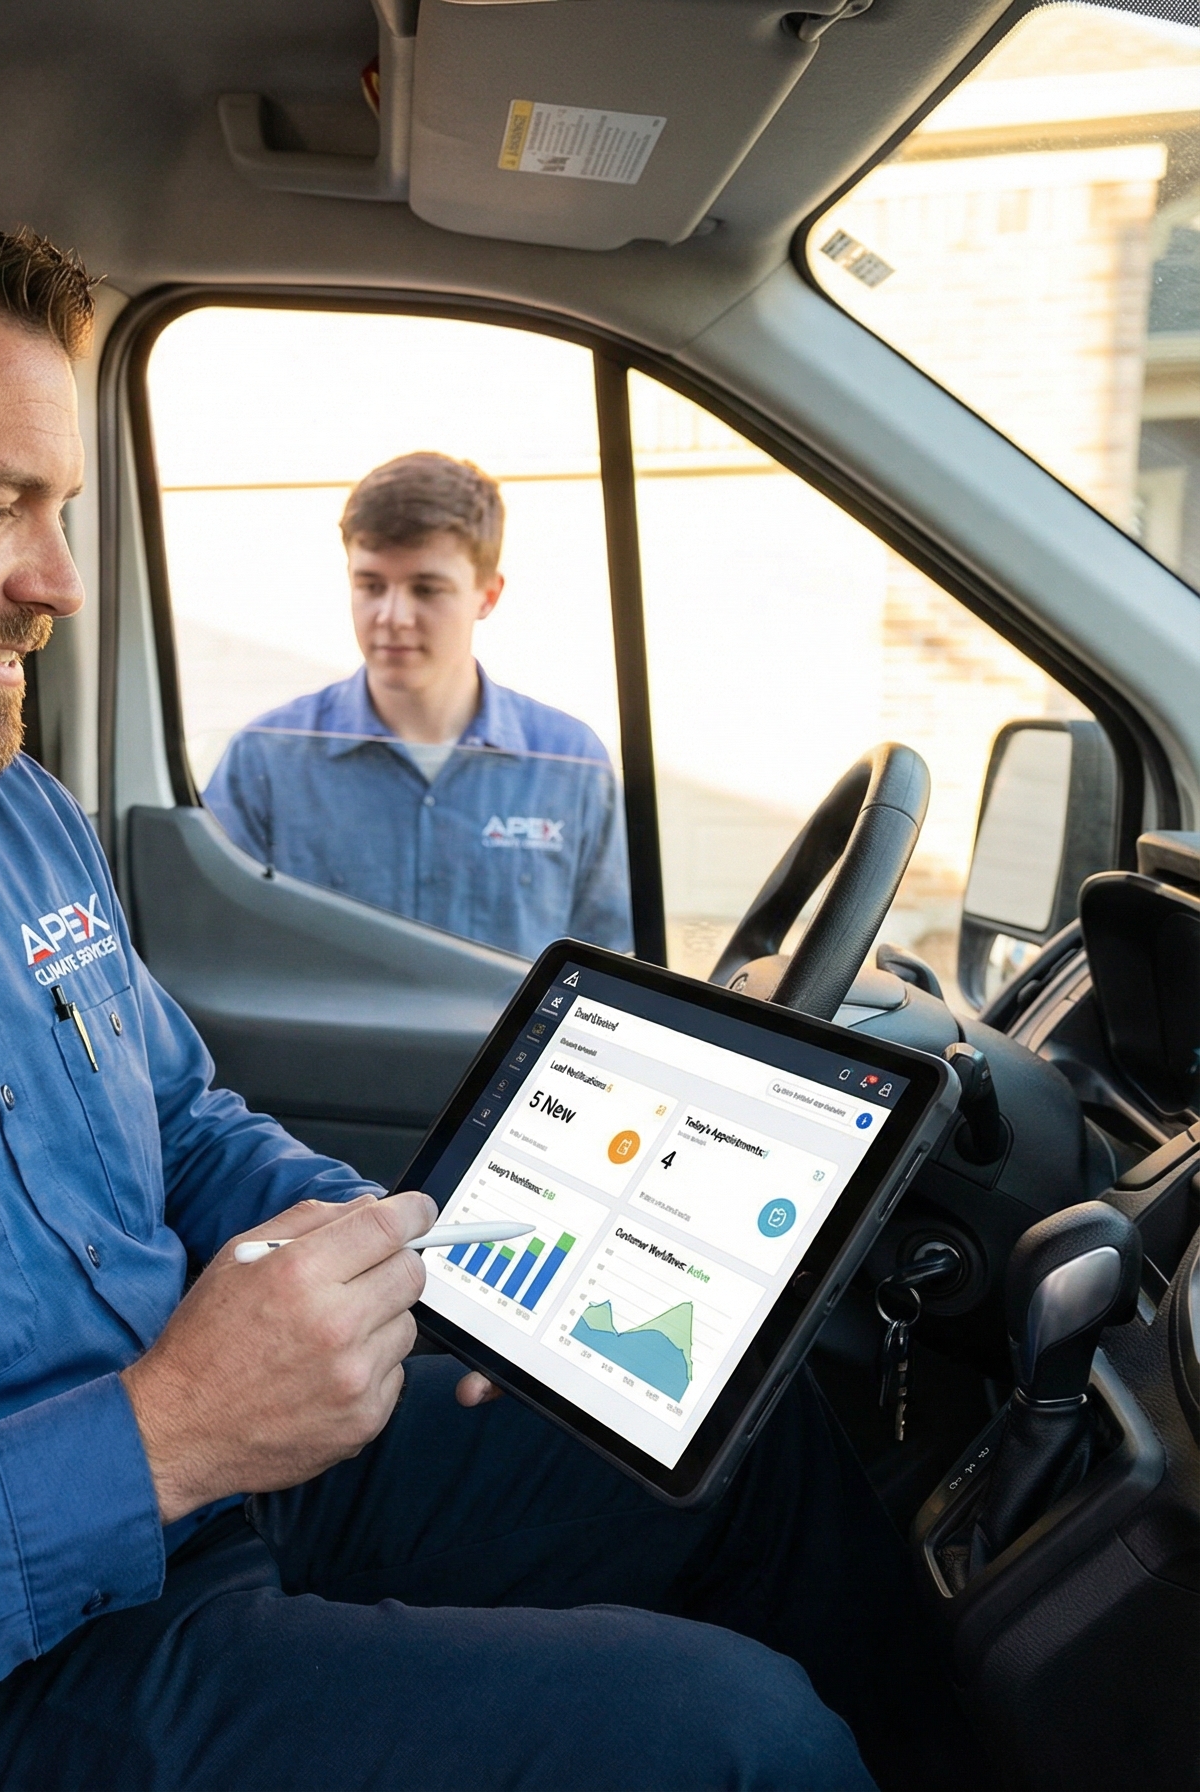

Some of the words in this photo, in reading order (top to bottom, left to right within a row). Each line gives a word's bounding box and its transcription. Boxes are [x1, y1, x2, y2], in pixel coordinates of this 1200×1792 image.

[481, 814, 565, 841] APEX
[20, 892, 111, 968] APEX
[34, 954, 80, 986] CLIMATE
[529, 1089, 544, 1108] 5
[540, 1094, 577, 1124] New
[660, 1150, 677, 1170] 4
